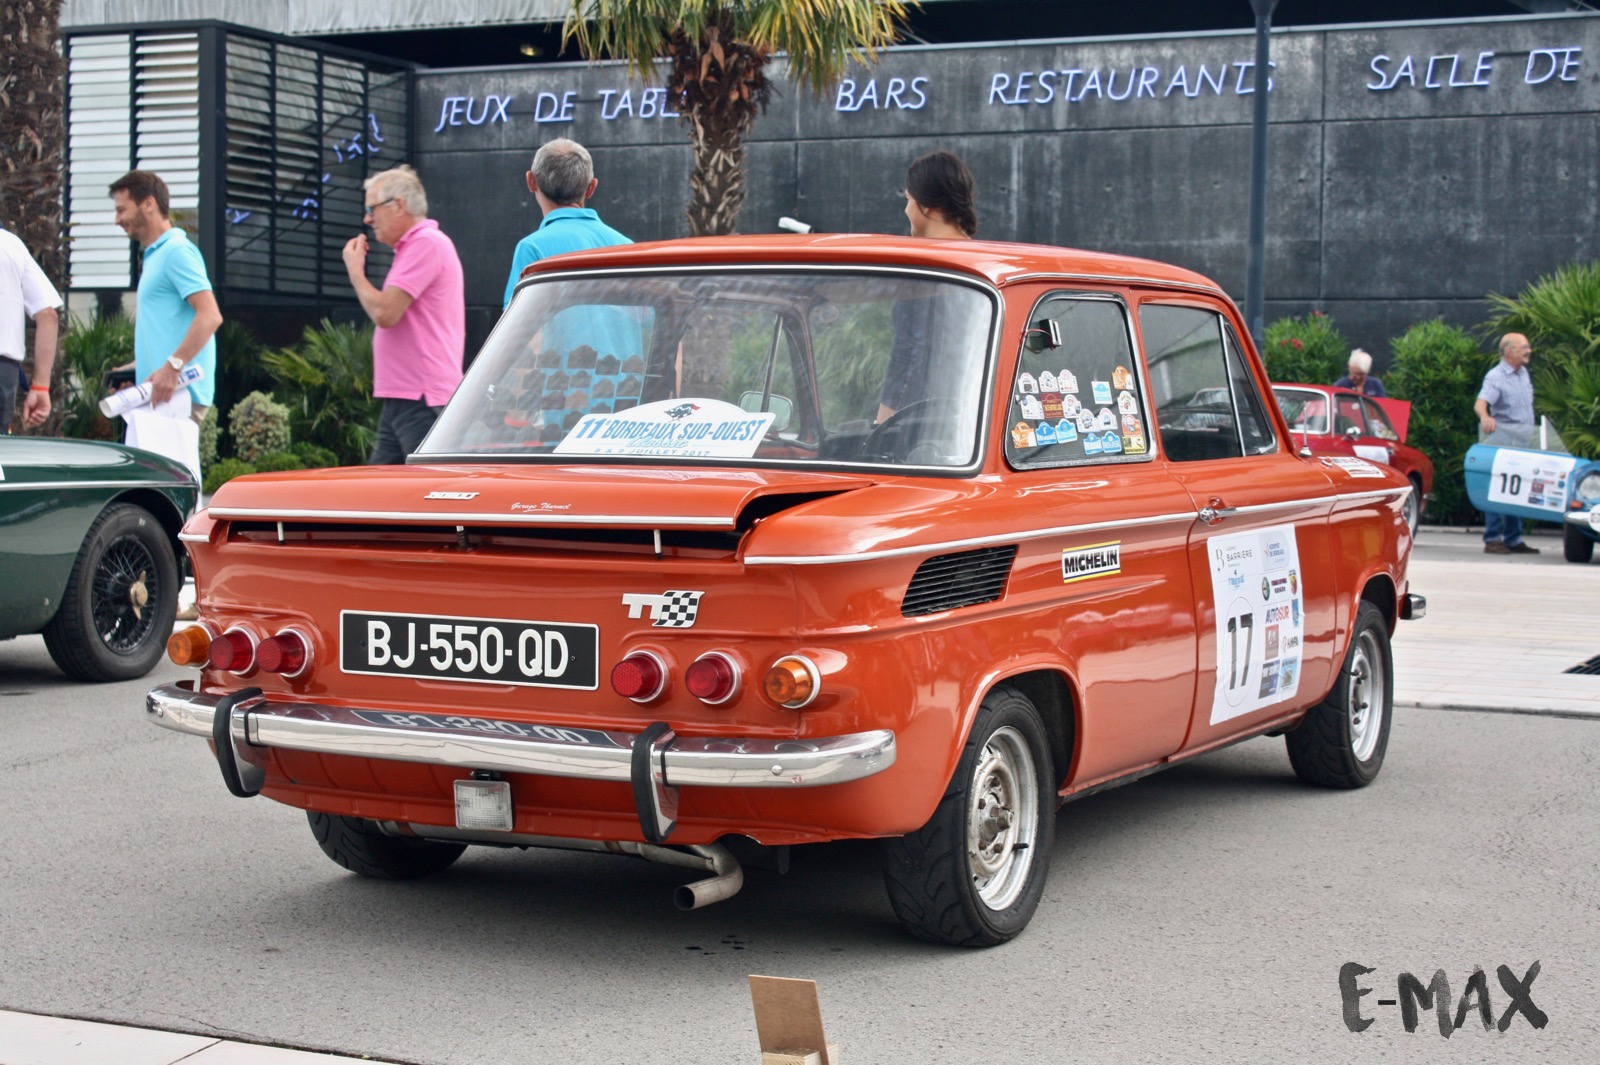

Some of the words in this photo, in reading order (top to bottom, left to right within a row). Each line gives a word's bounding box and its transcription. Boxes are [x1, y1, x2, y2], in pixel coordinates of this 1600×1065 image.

[1366, 51, 1495, 90] SALLE
[1524, 47, 1582, 84] DE
[434, 94, 513, 133] JEUX
[534, 91, 577, 123] DE
[598, 87, 688, 119] TABL
[834, 76, 928, 112] BARS
[601, 419, 681, 441] BORDEAUX
[678, 418, 766, 442] SUD-OUEST
[629, 448, 678, 456] JUILLET
[1500, 472, 1522, 496] 10
[1064, 549, 1118, 574] MICHELIN
[621, 591, 672, 621] TT
[366, 620, 569, 679] BJ-550-QD
[1227, 612, 1253, 690] 17
